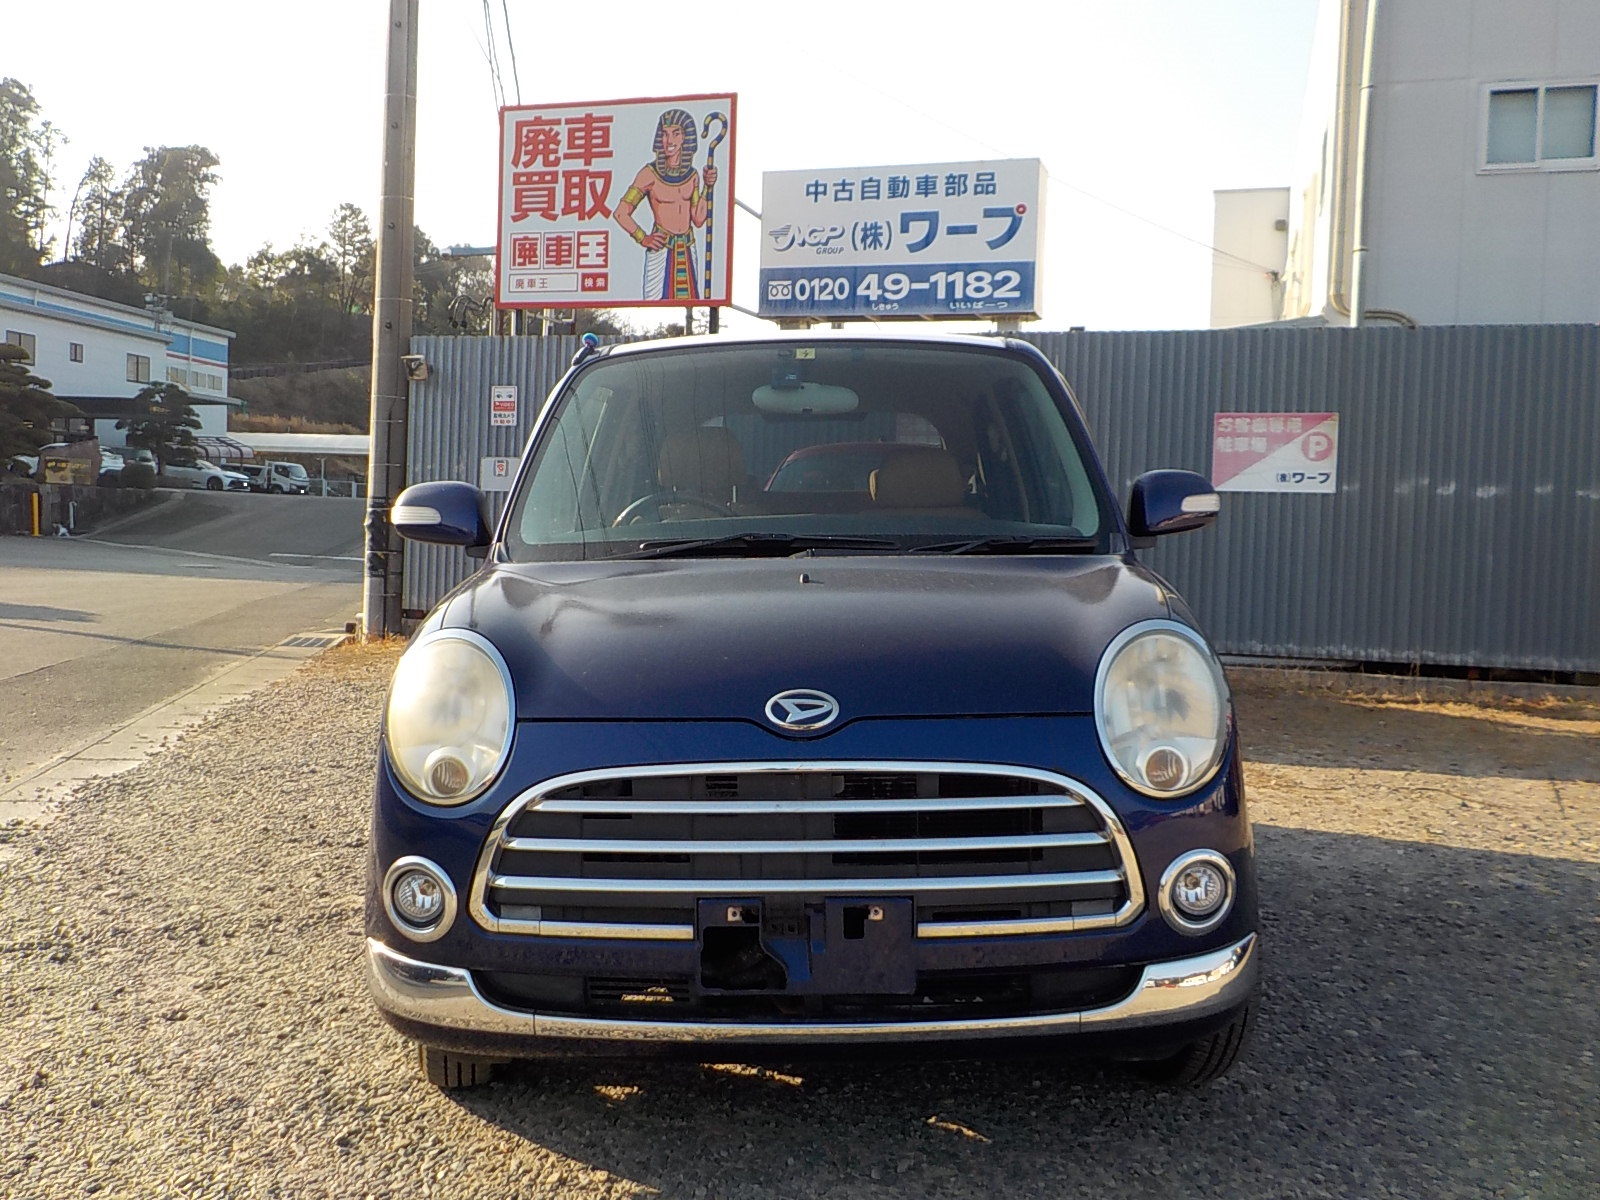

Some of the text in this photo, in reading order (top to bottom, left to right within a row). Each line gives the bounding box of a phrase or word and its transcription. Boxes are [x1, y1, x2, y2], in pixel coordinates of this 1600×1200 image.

[511, 113, 614, 169] 廃車
[510, 169, 613, 223] 買取
[805, 171, 997, 203] 中古自動車部品
[816, 246, 845, 255] GROUP
[515, 277, 548, 289] 廃車王
[794, 270, 1022, 301] 0120 49-1182
[1308, 435, 1329, 459] P
